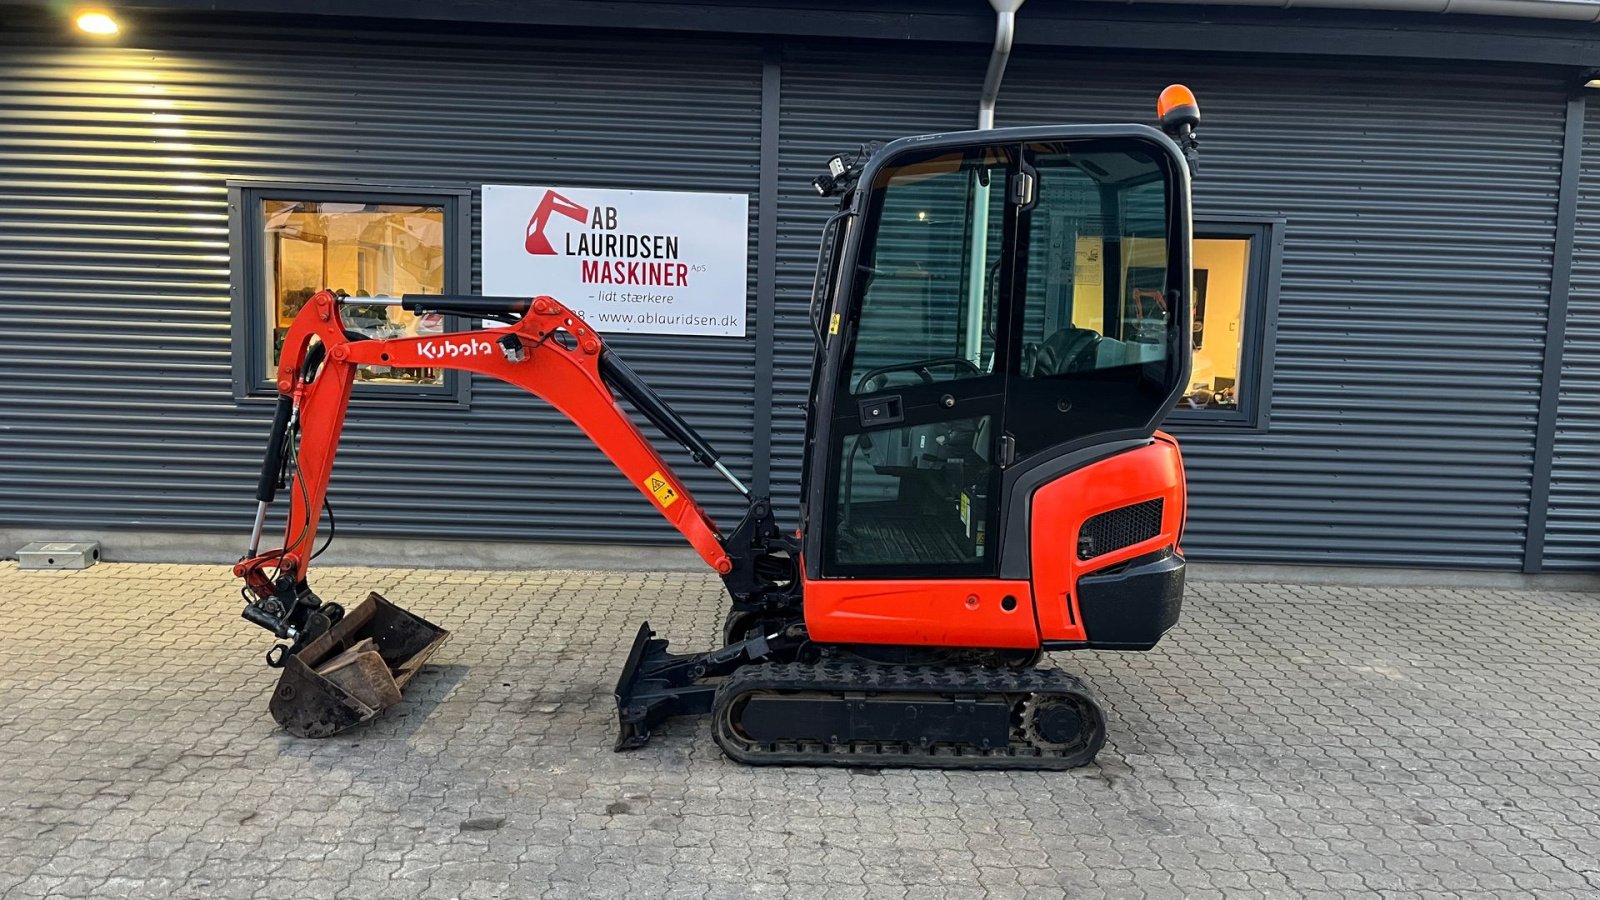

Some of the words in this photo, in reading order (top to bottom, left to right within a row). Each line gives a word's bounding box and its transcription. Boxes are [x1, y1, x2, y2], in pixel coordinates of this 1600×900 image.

[591, 206, 618, 231] AB
[566, 232, 678, 259] LAURIDSEN
[582, 260, 688, 287] MASKINER
[691, 264, 707, 272] ApS
[598, 290, 617, 302] lidt
[620, 292, 674, 304] stærkere
[598, 312, 738, 327] www.ablauridsen.dk
[417, 338, 492, 359] Kubota
